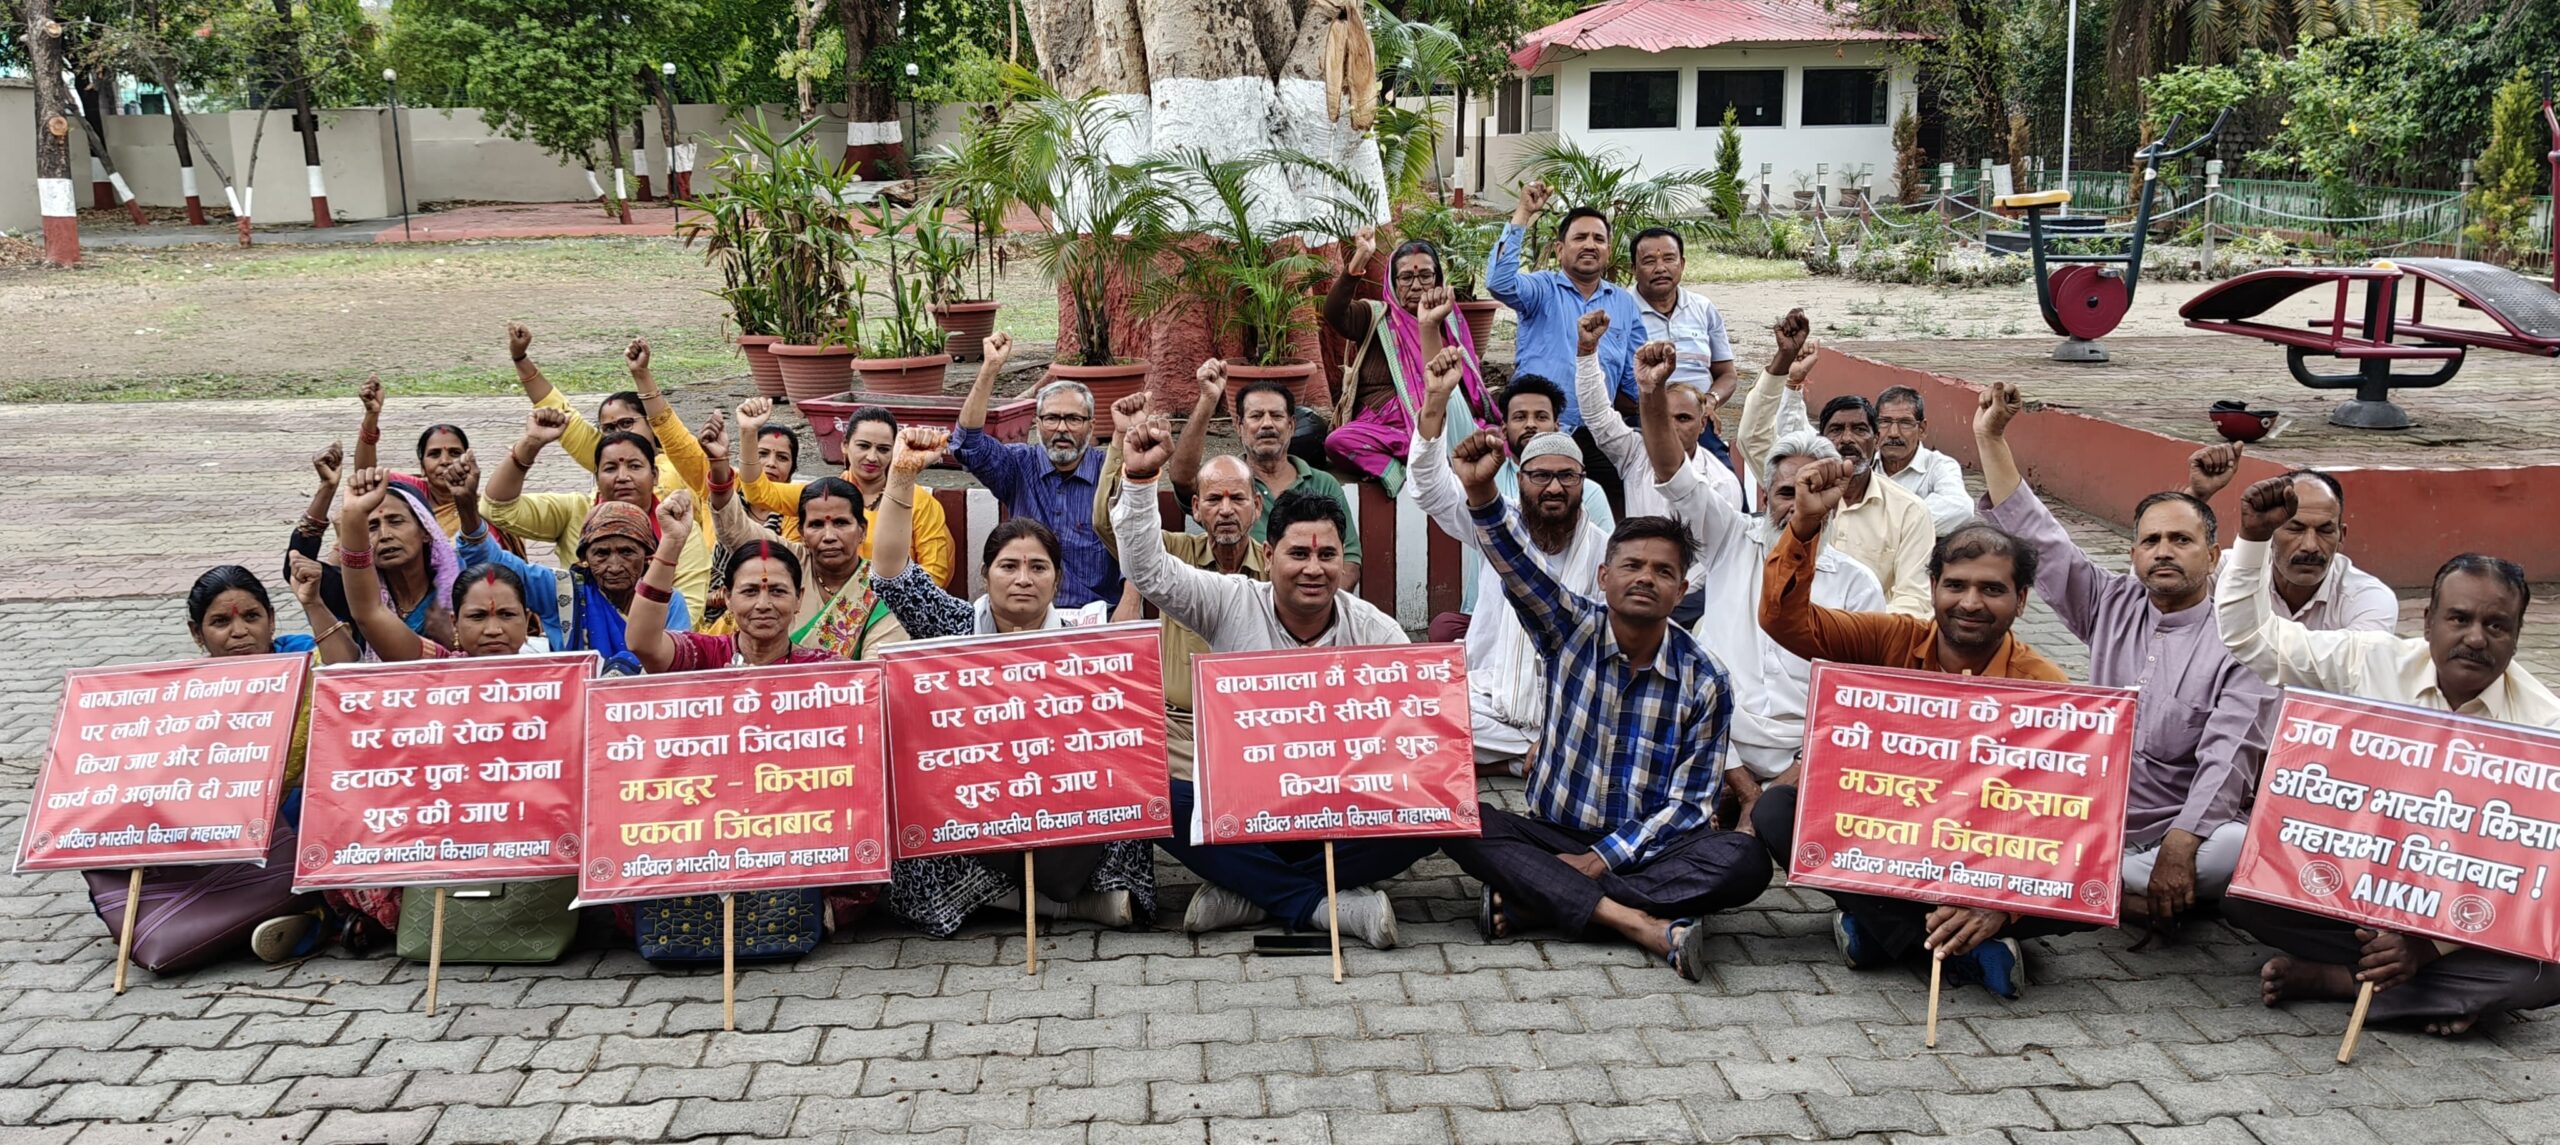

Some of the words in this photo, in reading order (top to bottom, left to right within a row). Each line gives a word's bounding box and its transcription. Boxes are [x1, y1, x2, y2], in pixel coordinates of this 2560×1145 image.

[79, 688, 158, 708] बागजाला
[162, 681, 180, 701] में
[184, 680, 243, 699] निर्माण
[247, 672, 289, 693] कार्य
[913, 672, 949, 693] हर
[958, 667, 994, 686] घर
[1002, 662, 1047, 682] नल
[1055, 653, 1133, 677] योजना
[1216, 672, 1317, 693] बागजाला
[1325, 664, 1345, 686] में
[1354, 661, 1408, 685] रोकी
[1416, 659, 1452, 682] गई
[340, 691, 376, 712] हर
[382, 689, 419, 708] घर
[426, 686, 472, 705] नल
[480, 679, 562, 702] योजना
[606, 696, 724, 722] बागजाला
[733, 689, 762, 713] के
[771, 679, 866, 714] ग्रामीणों
[930, 708, 966, 728] पर
[973, 698, 1026, 724] लगी
[1034, 694, 1084, 718] रोक
[1091, 687, 1125, 711] को
[1234, 702, 1326, 728] सरकारी
[1334, 698, 1391, 722] सीसी
[1399, 694, 1442, 718] रोड
[1836, 686, 1961, 719] बागजाला
[1969, 696, 2001, 722] के
[2010, 702, 2119, 735] ग्रामीणों
[81, 725, 106, 741] पर
[111, 717, 150, 740] लगी
[155, 715, 192, 735] रोक
[195, 711, 222, 731] को
[227, 711, 273, 729] खत्म
[351, 729, 385, 748] पर
[392, 720, 446, 747] लगी
[453, 719, 505, 743] रोक
[512, 716, 548, 740] को
[607, 734, 645, 761] की
[654, 735, 729, 757] एकता
[738, 725, 847, 752] जिंदाबाद
[2283, 717, 2342, 749] जन
[2350, 729, 2438, 768] एकता
[75, 753, 121, 774] किया
[124, 753, 159, 770] जाए
[164, 744, 203, 766] और
[208, 743, 271, 764] निर्माण
[918, 742, 1003, 771] हटाकर
[1010, 737, 1055, 764] पुनः
[1064, 727, 1144, 752] योजना
[1244, 744, 1276, 762] का
[1283, 740, 1336, 759] काम
[1344, 737, 1386, 760] पुनः
[1396, 736, 1438, 759] शुरू
[1831, 722, 1873, 750] की
[1882, 732, 1961, 760] एकता
[1969, 735, 2092, 778] जिंदाबाद
[330, 767, 417, 791] हटाकर
[424, 764, 469, 790] पुनः
[480, 757, 563, 781] योजना
[620, 775, 718, 804] मजदूर
[754, 763, 855, 793] किसान
[956, 782, 1000, 808] शुरू
[1008, 772, 1042, 796] की
[1050, 771, 1097, 793] जाए
[1280, 773, 1342, 796] किया
[1349, 774, 1394, 792] जाए
[48, 792, 86, 809] कार्य
[92, 784, 118, 804] की
[123, 779, 193, 806] अनुमति
[198, 778, 221, 800] दी
[225, 780, 262, 798] जाए
[1840, 768, 1942, 808] मजदूर
[1980, 778, 2094, 820] किसान
[2270, 764, 2368, 810] अखिल
[2370, 790, 2475, 832] भारतीय
[2480, 800, 2560, 849] किसा
[363, 807, 409, 832] शुरू
[417, 800, 452, 824] की
[460, 802, 510, 822] जाए
[620, 819, 704, 846] एकता
[714, 808, 834, 839] जिंदाबाद
[932, 819, 979, 842] अखिल
[982, 813, 1032, 836] भारतीय
[1036, 809, 1083, 830] किसान
[1086, 805, 1141, 824] महासभा
[1245, 811, 1291, 833] अखिल
[1294, 807, 1342, 828] भारतीय
[1346, 805, 1394, 826] किसान
[1397, 808, 1451, 824] महासभा
[55, 827, 97, 848] अखिल
[99, 824, 144, 846] भारतीय
[147, 823, 188, 844] किसान
[191, 825, 242, 842] महासभा
[332, 843, 380, 864] अखिल
[383, 840, 436, 862] भारतीय
[440, 838, 489, 859] किसान
[493, 840, 550, 857] महासभा
[1836, 813, 1922, 845] एकता
[1931, 819, 2063, 866] जिंदाबाद
[622, 854, 673, 877] अखिल
[676, 850, 729, 872] भारतीय
[734, 848, 786, 869] किसान
[790, 847, 849, 864] महासभा
[1832, 848, 1885, 873] अखिल
[1887, 855, 1945, 881] भारतीय
[1949, 862, 2004, 889] किसान
[2008, 876, 2073, 898] महासभा
[2280, 818, 2395, 865] महासभा
[2397, 834, 2525, 894] जिंदाबाद
[2351, 873, 2442, 918] AIKM
